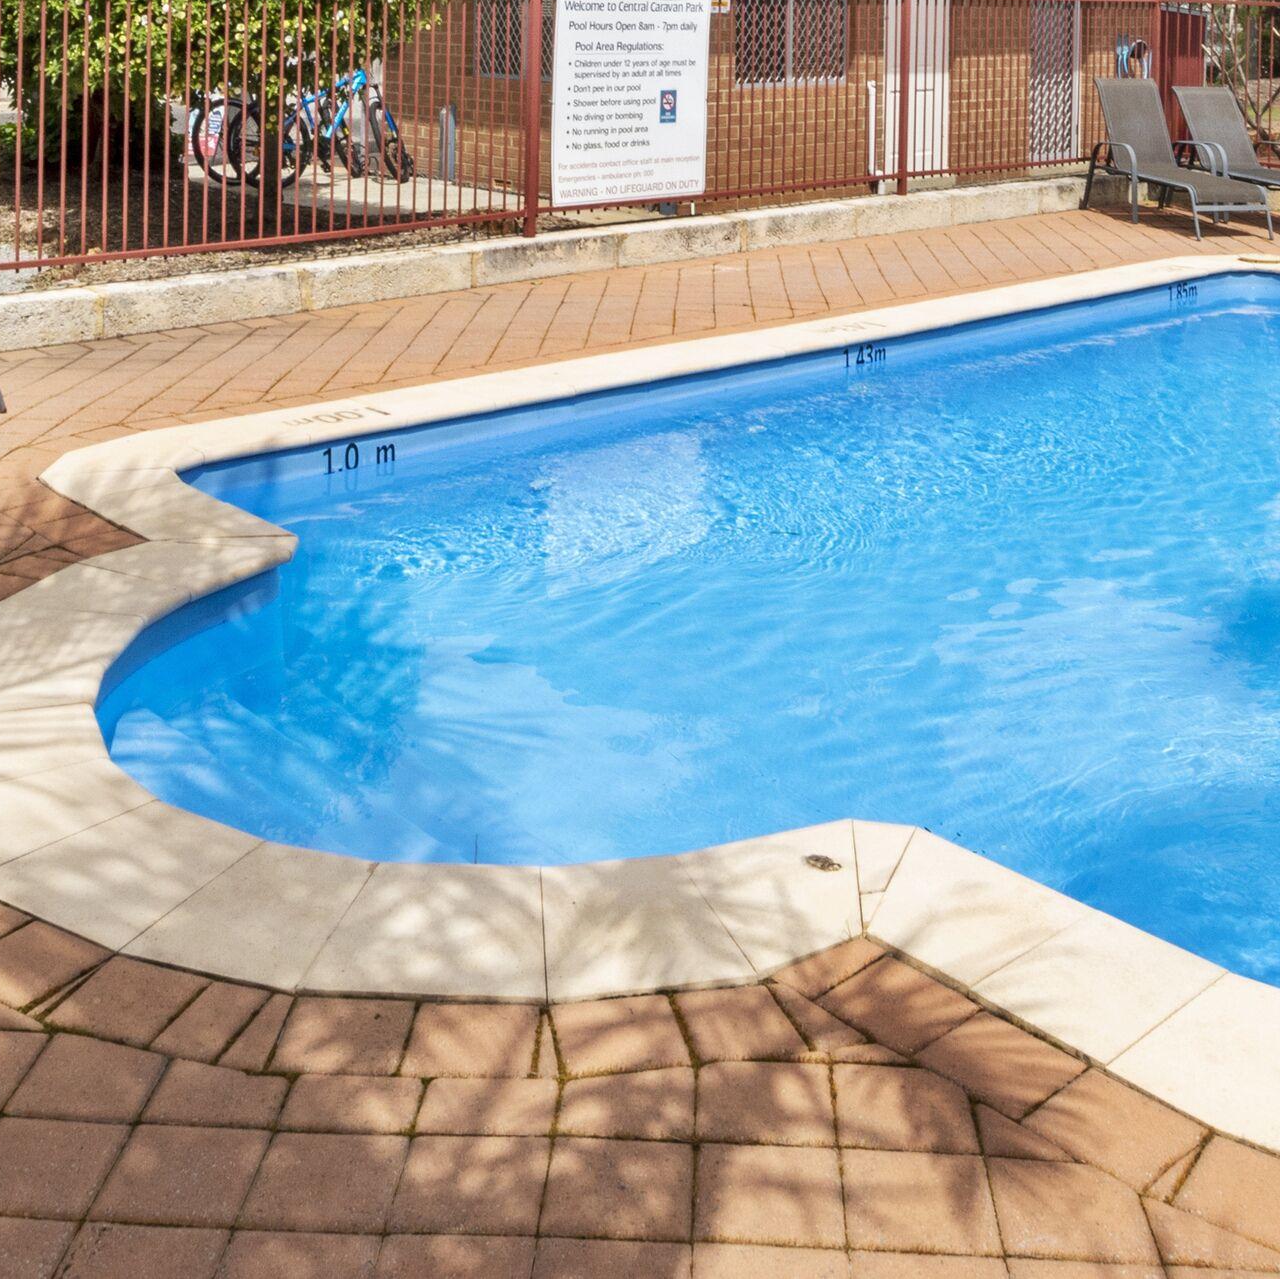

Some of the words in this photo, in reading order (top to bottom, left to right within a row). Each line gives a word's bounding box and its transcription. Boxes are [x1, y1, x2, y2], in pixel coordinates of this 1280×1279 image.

[565, 1, 604, 11] Welcome
[608, 2, 616, 11] to
[618, 1, 648, 12] Central
[651, 2, 683, 12] Caravan
[686, 2, 703, 12] Park
[569, 21, 587, 30] Pool
[589, 21, 613, 30] Hours
[616, 21, 636, 32] Open
[639, 21, 654, 30] 8am
[662, 22, 678, 32] 7pm
[680, 22, 697, 32] daily
[575, 42, 593, 51] Pool
[596, 42, 614, 50] Area
[617, 42, 664, 53] Regulations:
[574, 60, 601, 68] Children
[632, 60, 649, 68] years
[659, 60, 670, 68] age
[574, 71, 610, 79] supervised
[612, 70, 620, 78] by
[665, 69, 682, 77] times
[574, 85, 591, 93] Don't
[626, 84, 641, 92] pool
[573, 99, 598, 107] Shower
[600, 98, 621, 106] before
[623, 99, 640, 107] using
[642, 97, 656, 106] pool
[584, 113, 604, 121] diving
[615, 112, 643, 121] bombing
[572, 128, 582, 136] No
[584, 127, 609, 136] running
[619, 125, 633, 134] pool
[583, 142, 603, 151] glass,
[605, 140, 620, 148] food
[630, 139, 650, 147] drinks
[560, 187, 598, 198] WARNING
[606, 186, 618, 195] NO
[620, 182, 663, 194] LIFEGUARD
[665, 181, 678, 190] ON
[679, 180, 699, 189] DUTY
[1167, 282, 1198, 302] 185m
[842, 344, 887, 368] 143m
[375, 442, 396, 465] m
